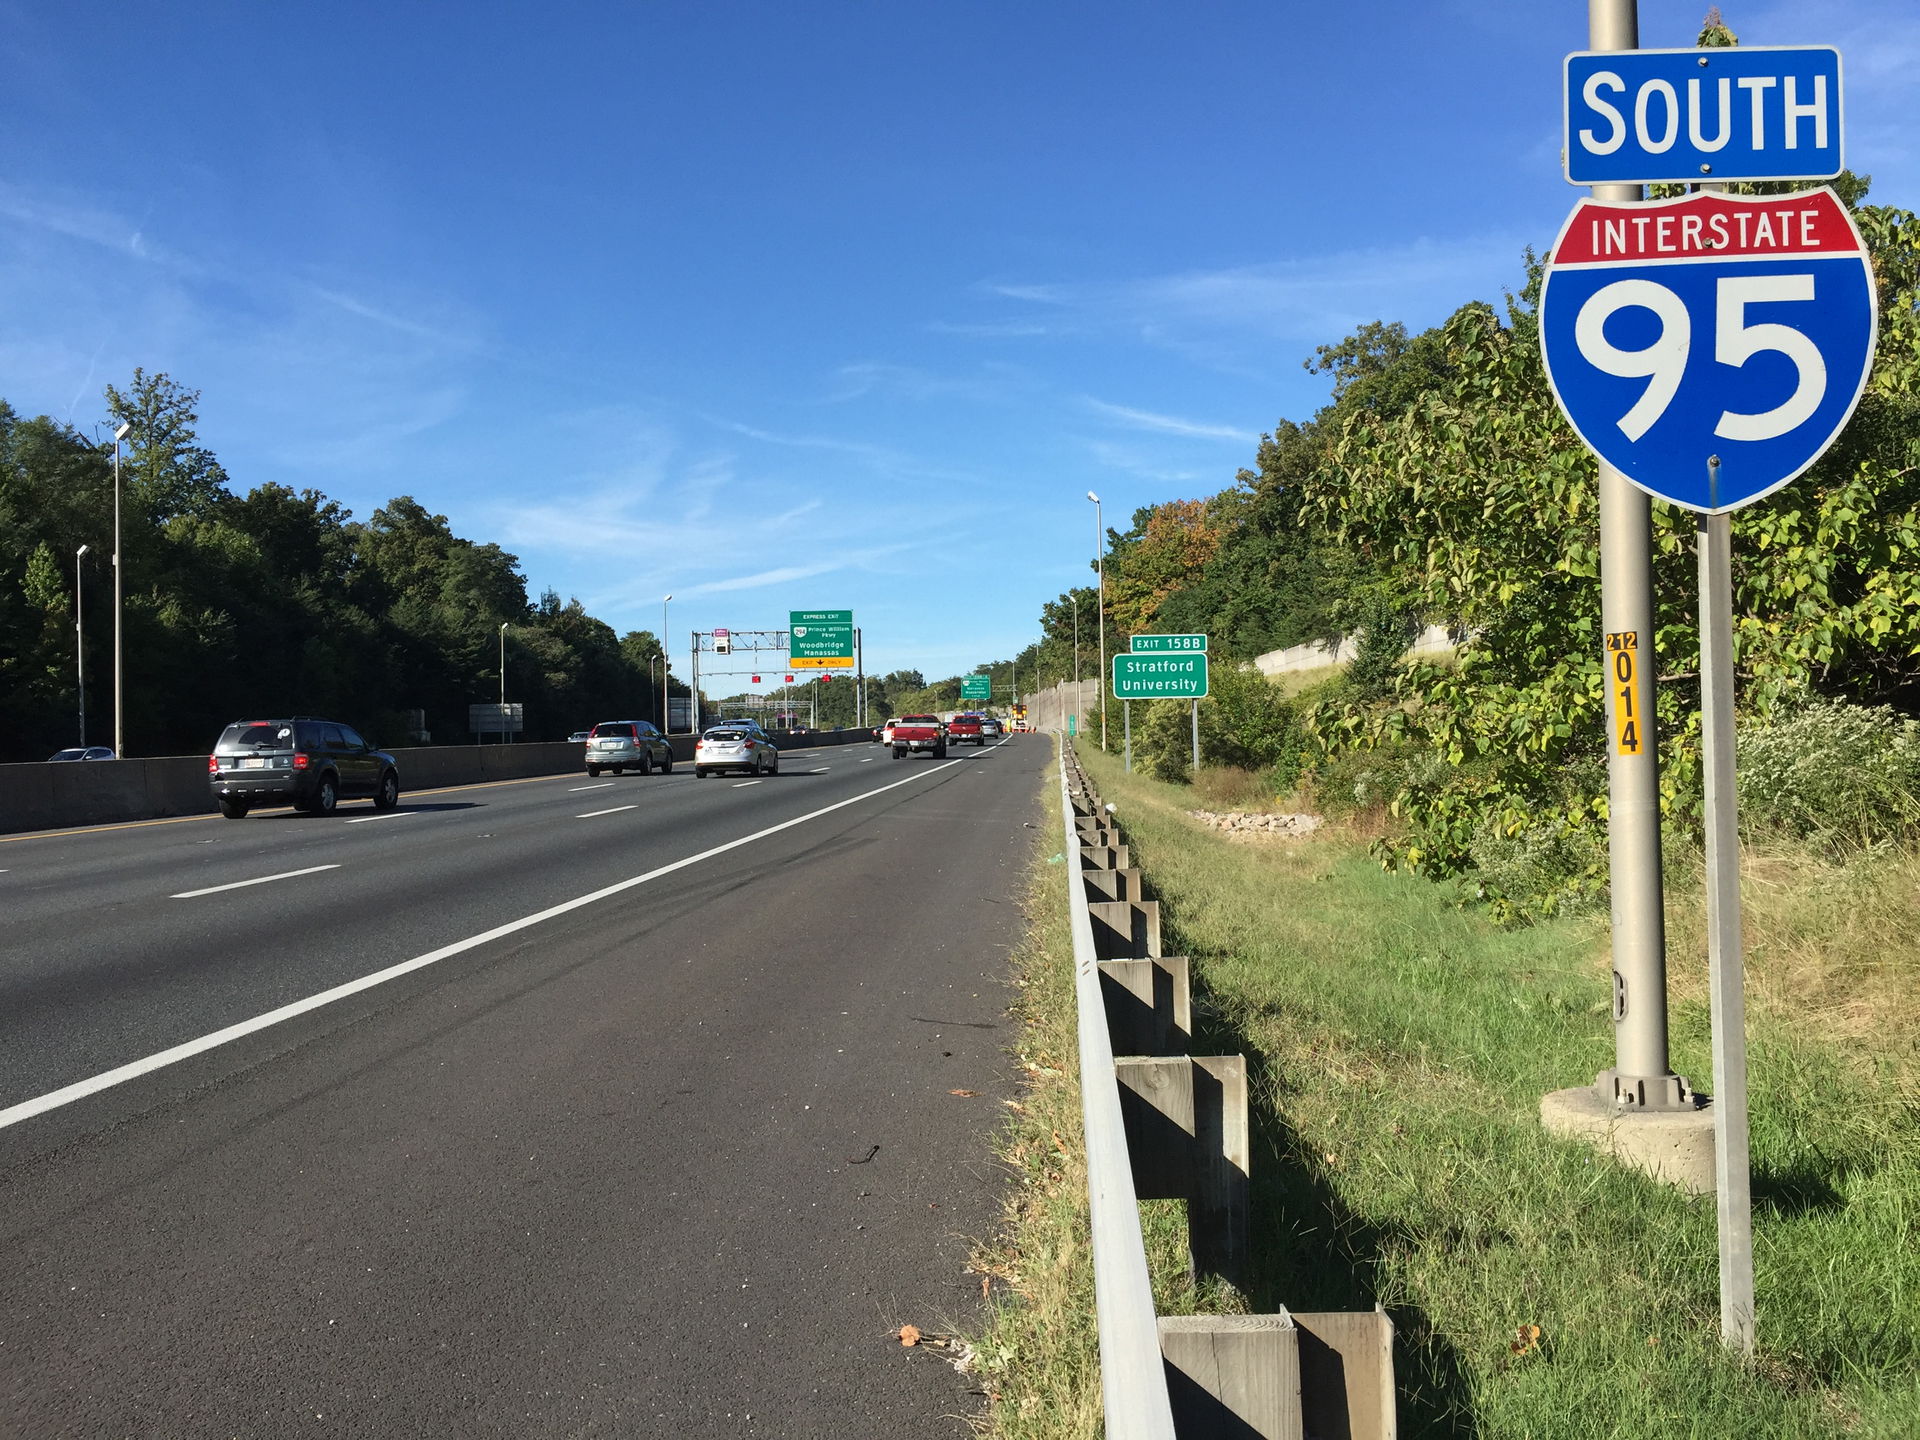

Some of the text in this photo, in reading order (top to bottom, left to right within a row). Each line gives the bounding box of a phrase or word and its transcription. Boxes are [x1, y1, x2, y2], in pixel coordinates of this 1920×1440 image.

[1579, 71, 1828, 155] SOUTH
[1592, 210, 1820, 256] INTERSTATE
[1575, 274, 1827, 443] 95
[799, 642, 844, 650] Woodbridge
[1136, 637, 1200, 649] EXIT 158B
[1607, 631, 1636, 651] 212
[1126, 660, 1194, 673] Stratford
[1122, 678, 1198, 693] University
